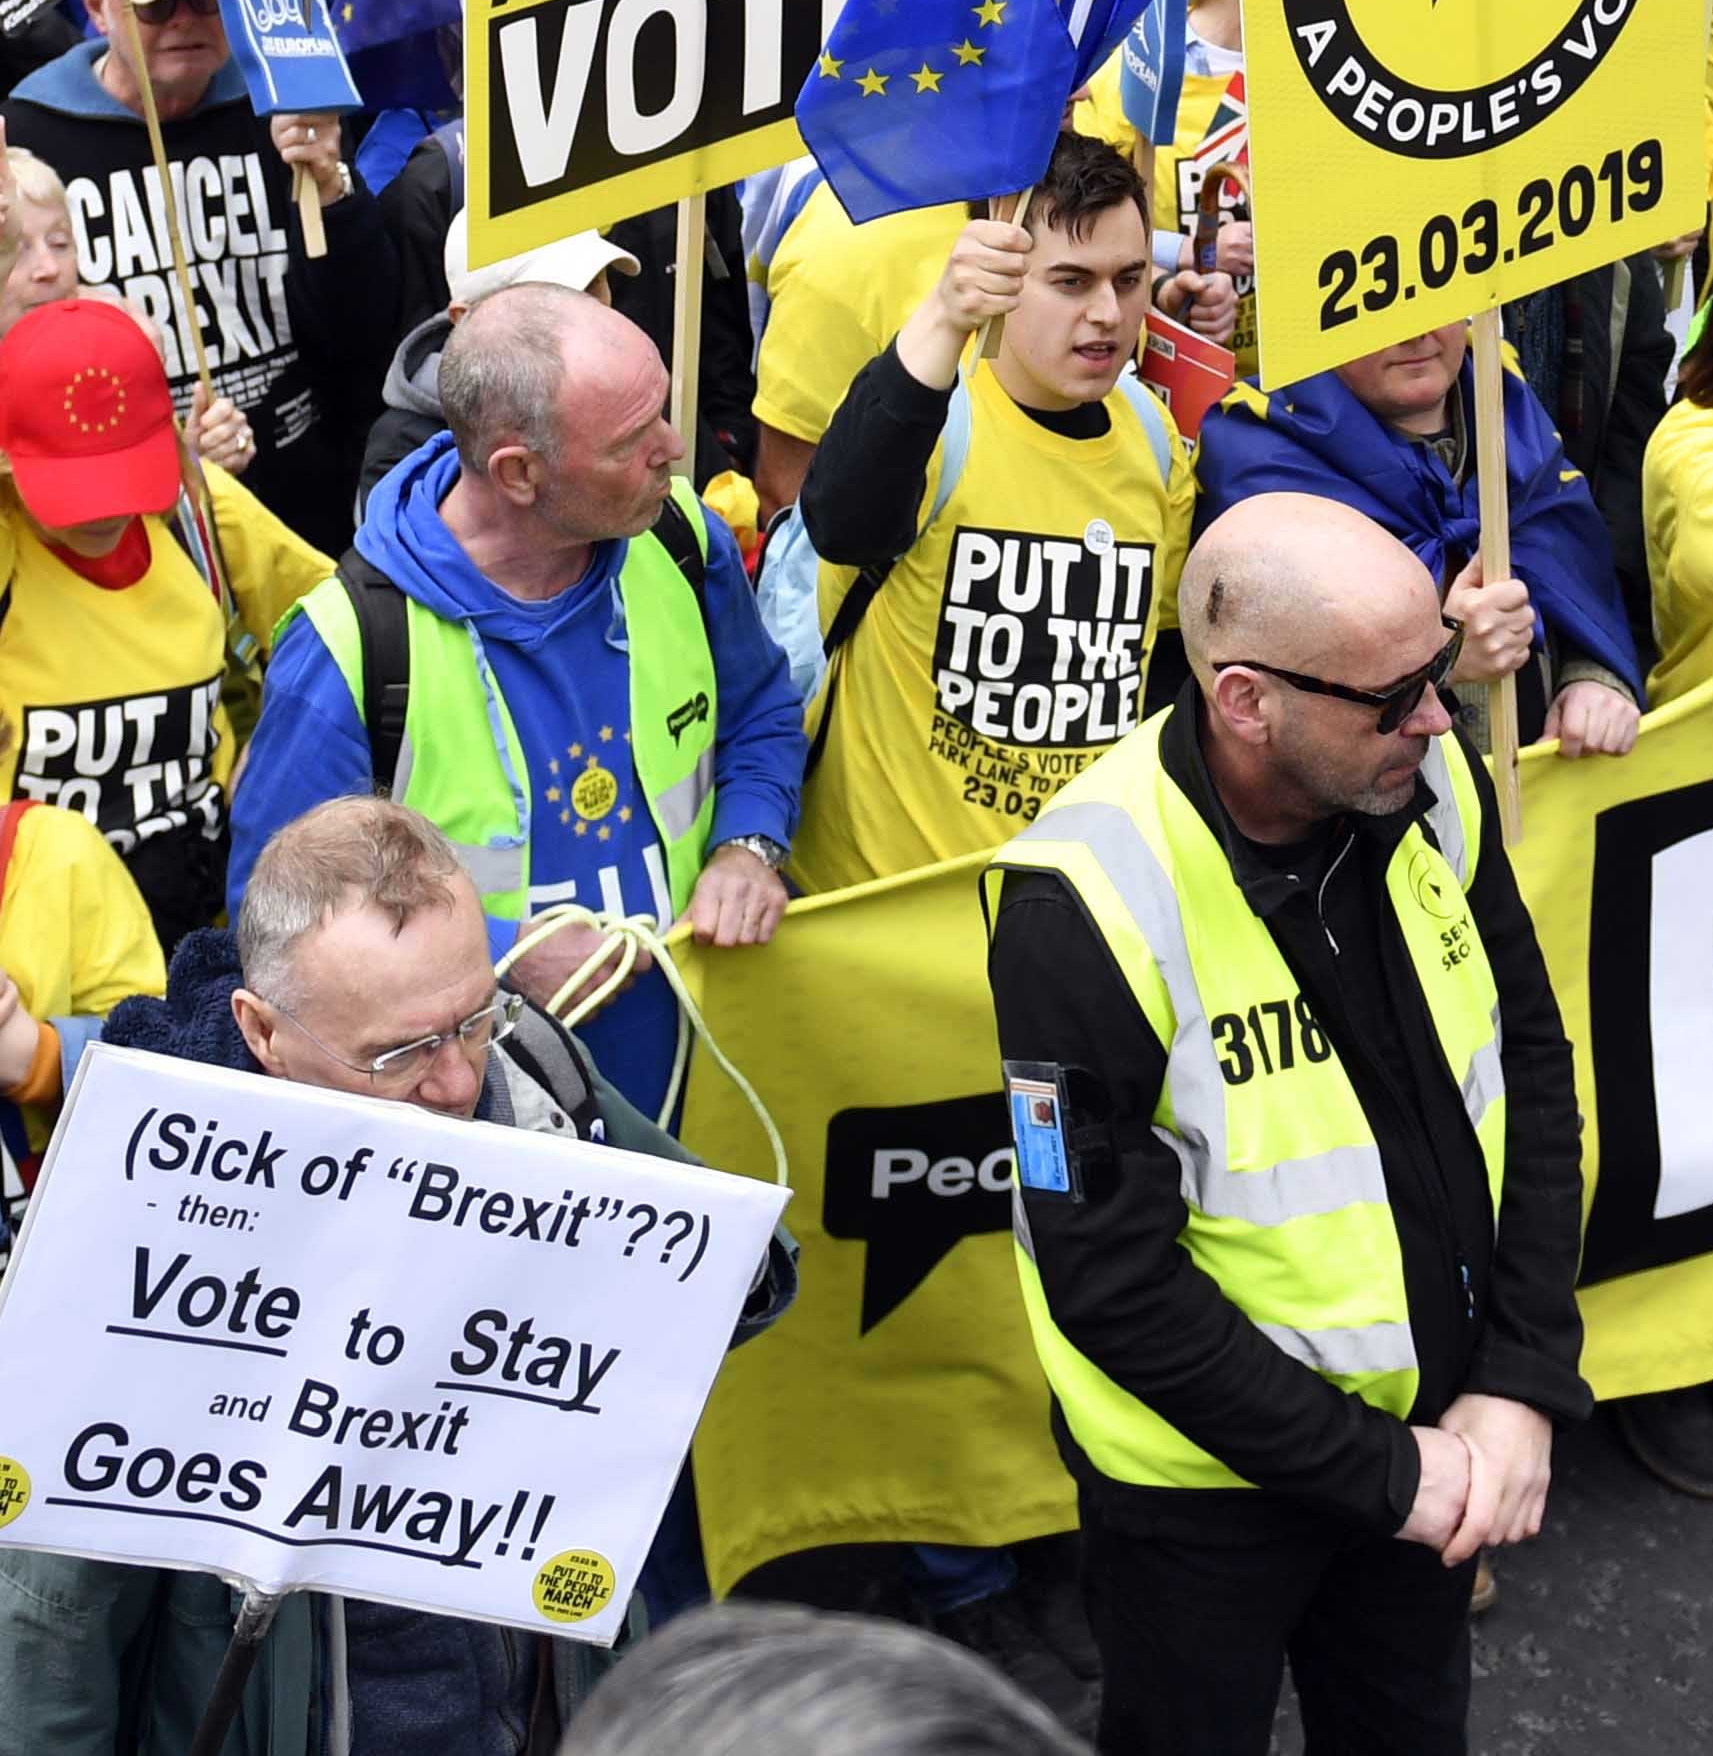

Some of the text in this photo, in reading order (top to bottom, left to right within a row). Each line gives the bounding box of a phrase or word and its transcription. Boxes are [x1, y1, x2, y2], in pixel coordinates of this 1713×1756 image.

[65, 152, 289, 286] CANCEL
[1317, 137, 1665, 332] 23.03.2019
[949, 533, 1153, 625] PUT IT
[944, 610, 1145, 681] TO THE
[22, 696, 170, 776] PUT
[932, 715, 1086, 774] PEOPLE'S VOTE
[936, 669, 1140, 743] PEOPLE
[928, 737, 1023, 787] PARK LANE
[123, 1106, 281, 1190] (Sick
[299, 1143, 368, 1204] of
[175, 1191, 261, 1236] then:
[129, 1243, 623, 1409] Vote to Stay
[208, 1377, 472, 1457] and Brexit
[4, 1478, 18, 1489] TO
[62, 1420, 558, 1568] Goes Away!!
